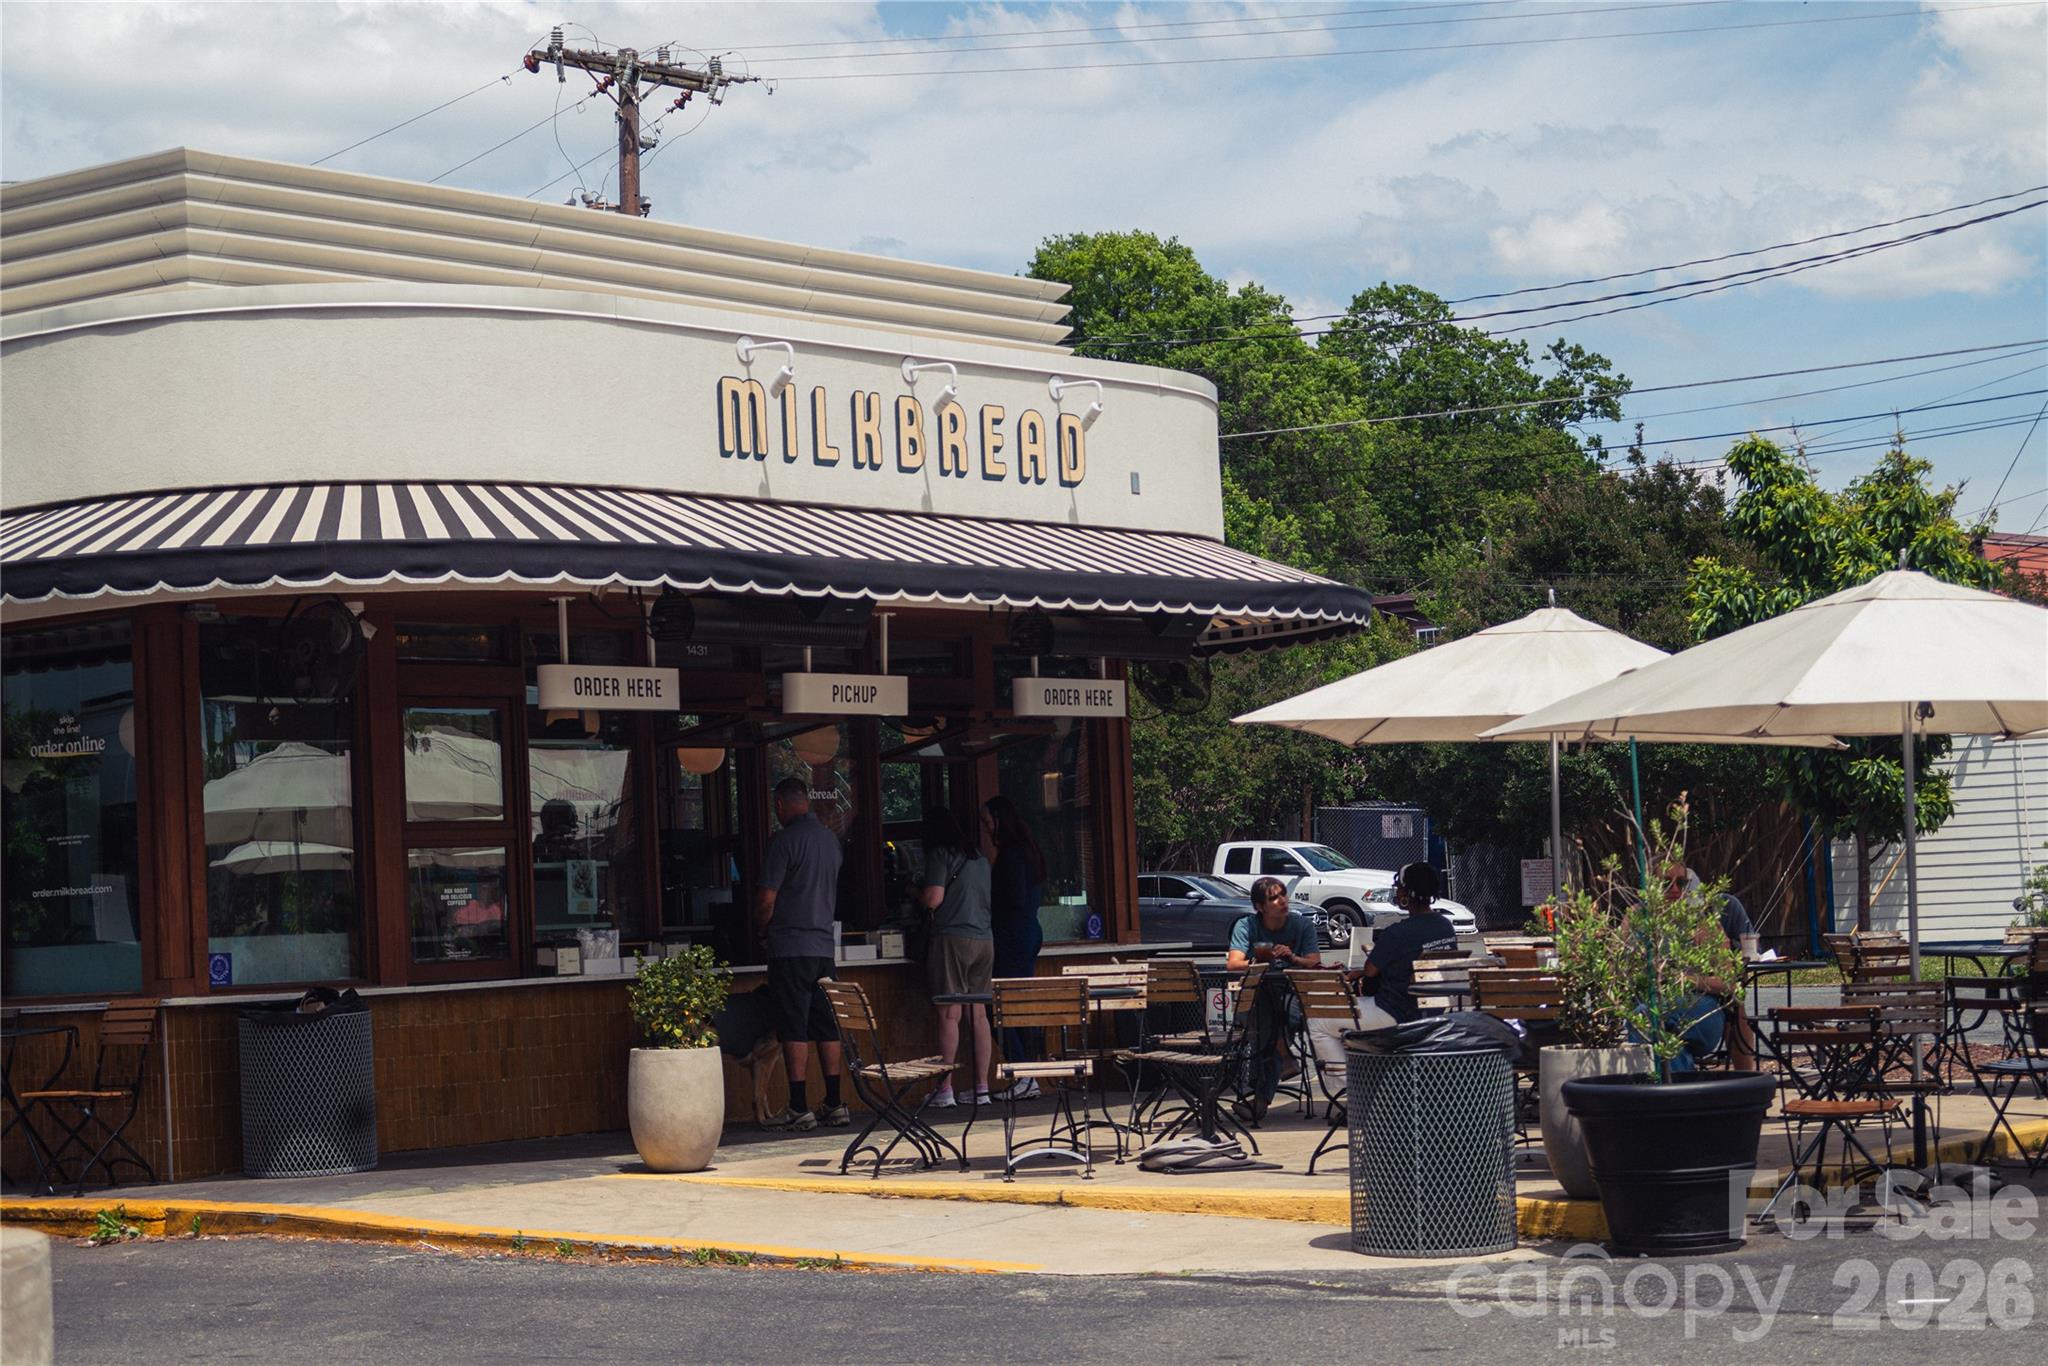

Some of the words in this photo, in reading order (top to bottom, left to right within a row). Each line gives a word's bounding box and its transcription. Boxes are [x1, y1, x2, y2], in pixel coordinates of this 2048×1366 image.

[717, 376, 1087, 489] MILKBREAD
[686, 645, 708, 656] 1431
[574, 677, 620, 696] ORDER
[627, 678, 662, 698] HERE
[832, 685, 877, 703] PICKUP
[1044, 688, 1080, 706] ORDER
[1085, 690, 1113, 706] HERE
[59, 715, 75, 725] skip
[53, 728, 65, 736] the
[30, 740, 65, 757] order
[65, 736, 106, 753] online
[32, 885, 113, 898] order.milkbread.com
